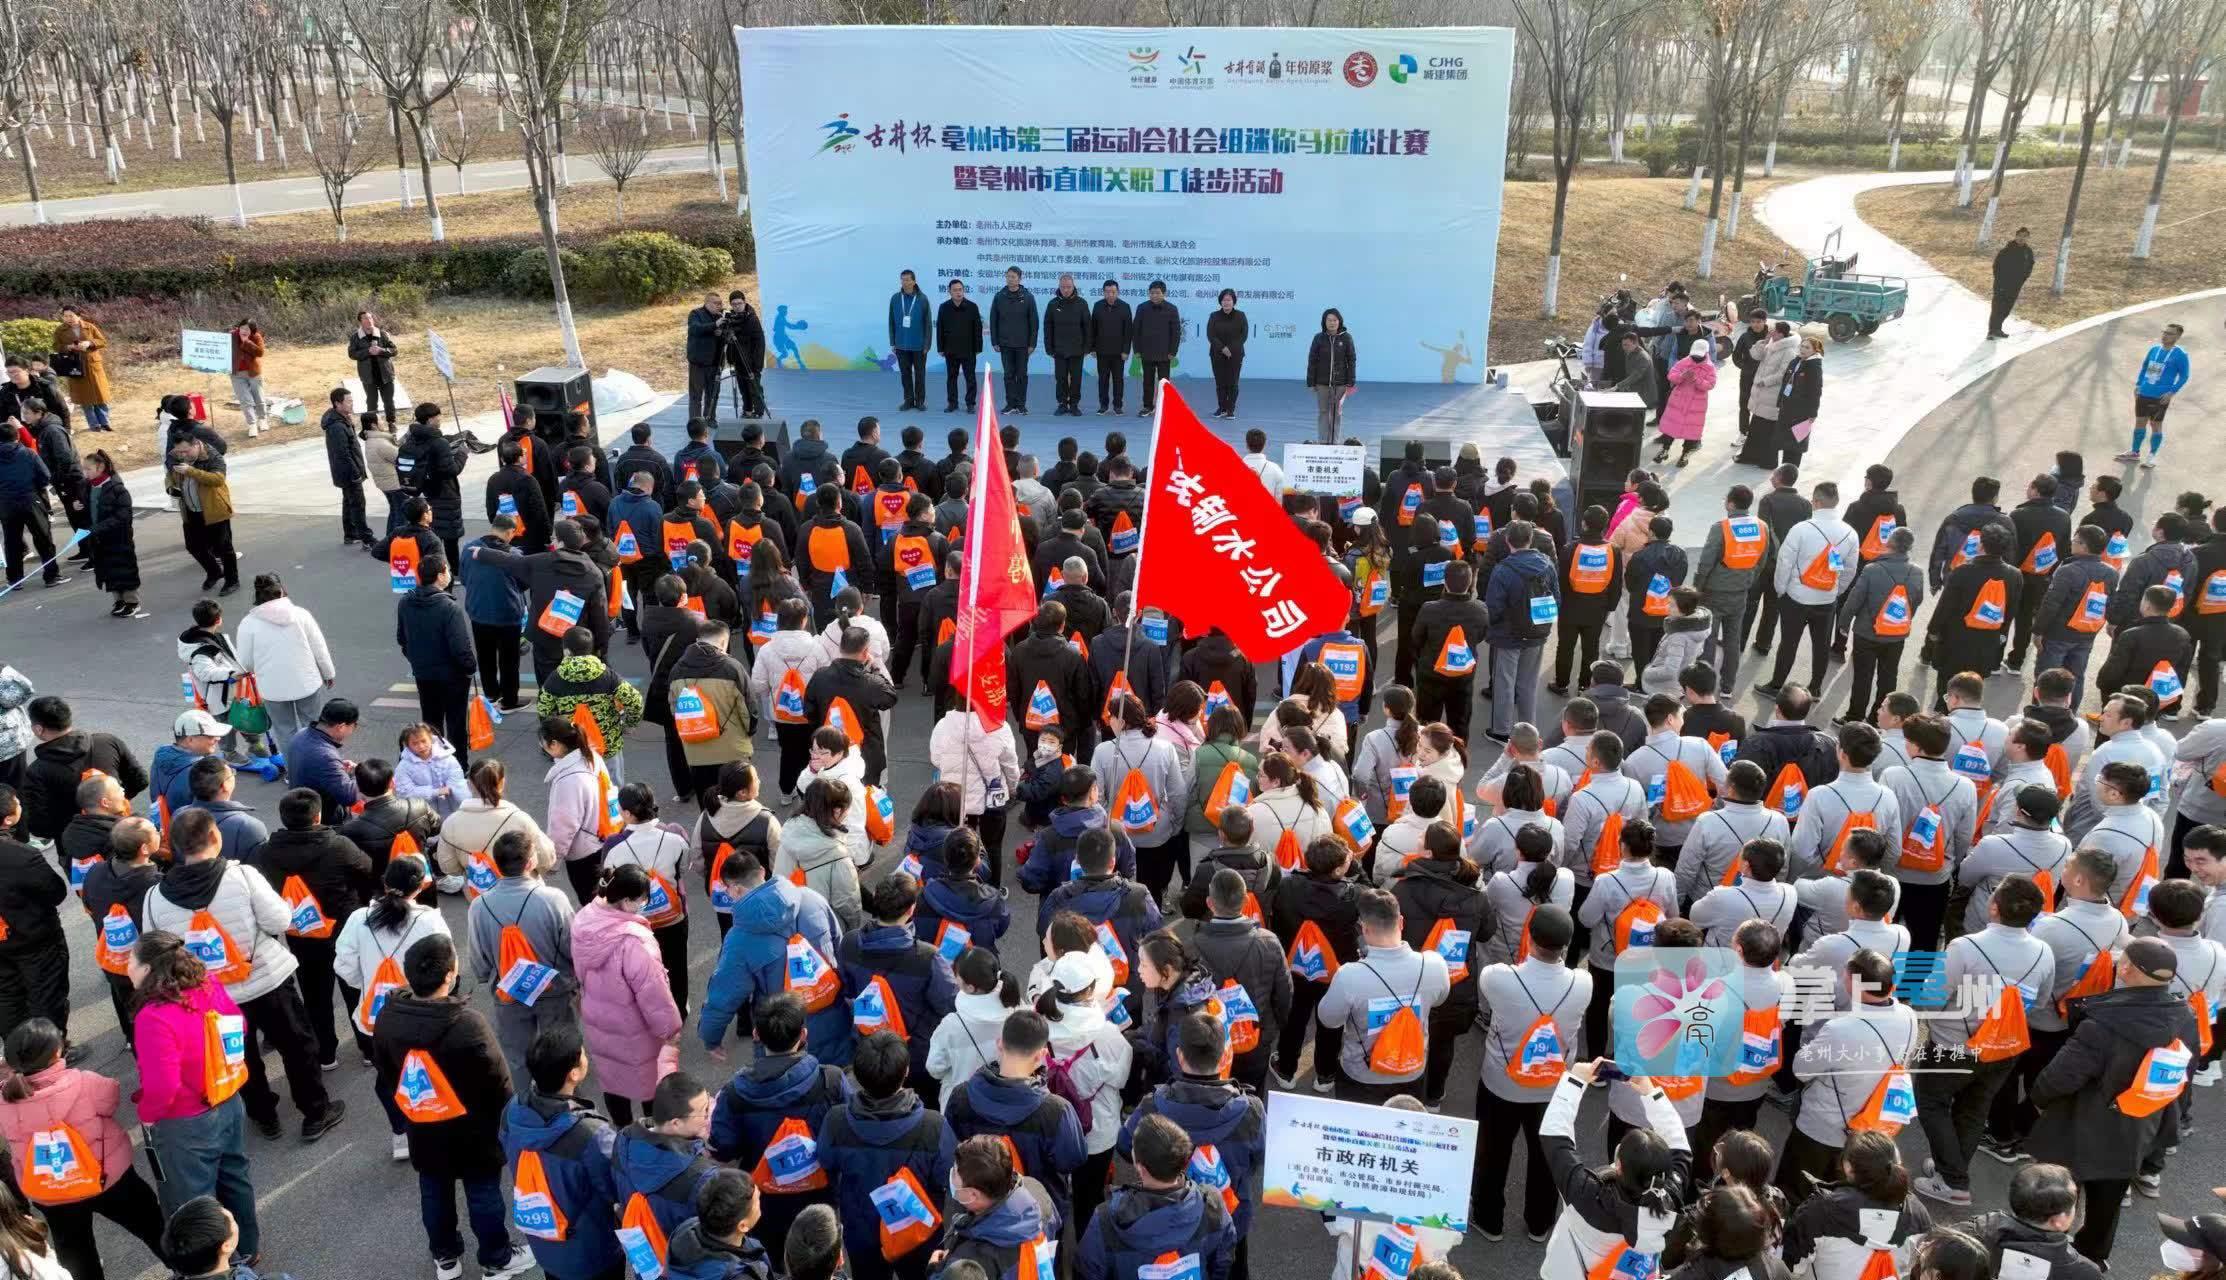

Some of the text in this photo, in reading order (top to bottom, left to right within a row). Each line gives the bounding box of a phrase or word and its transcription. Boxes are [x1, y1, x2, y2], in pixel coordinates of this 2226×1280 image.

[1286, 59, 1333, 75] 年份原浆
[1429, 57, 1464, 68] CJHG
[1423, 69, 1468, 81] 城建集团
[953, 165, 1284, 194] 暨亳州市直机关职工徒步活动
[1316, 1146, 1419, 1176] 市政府机关
